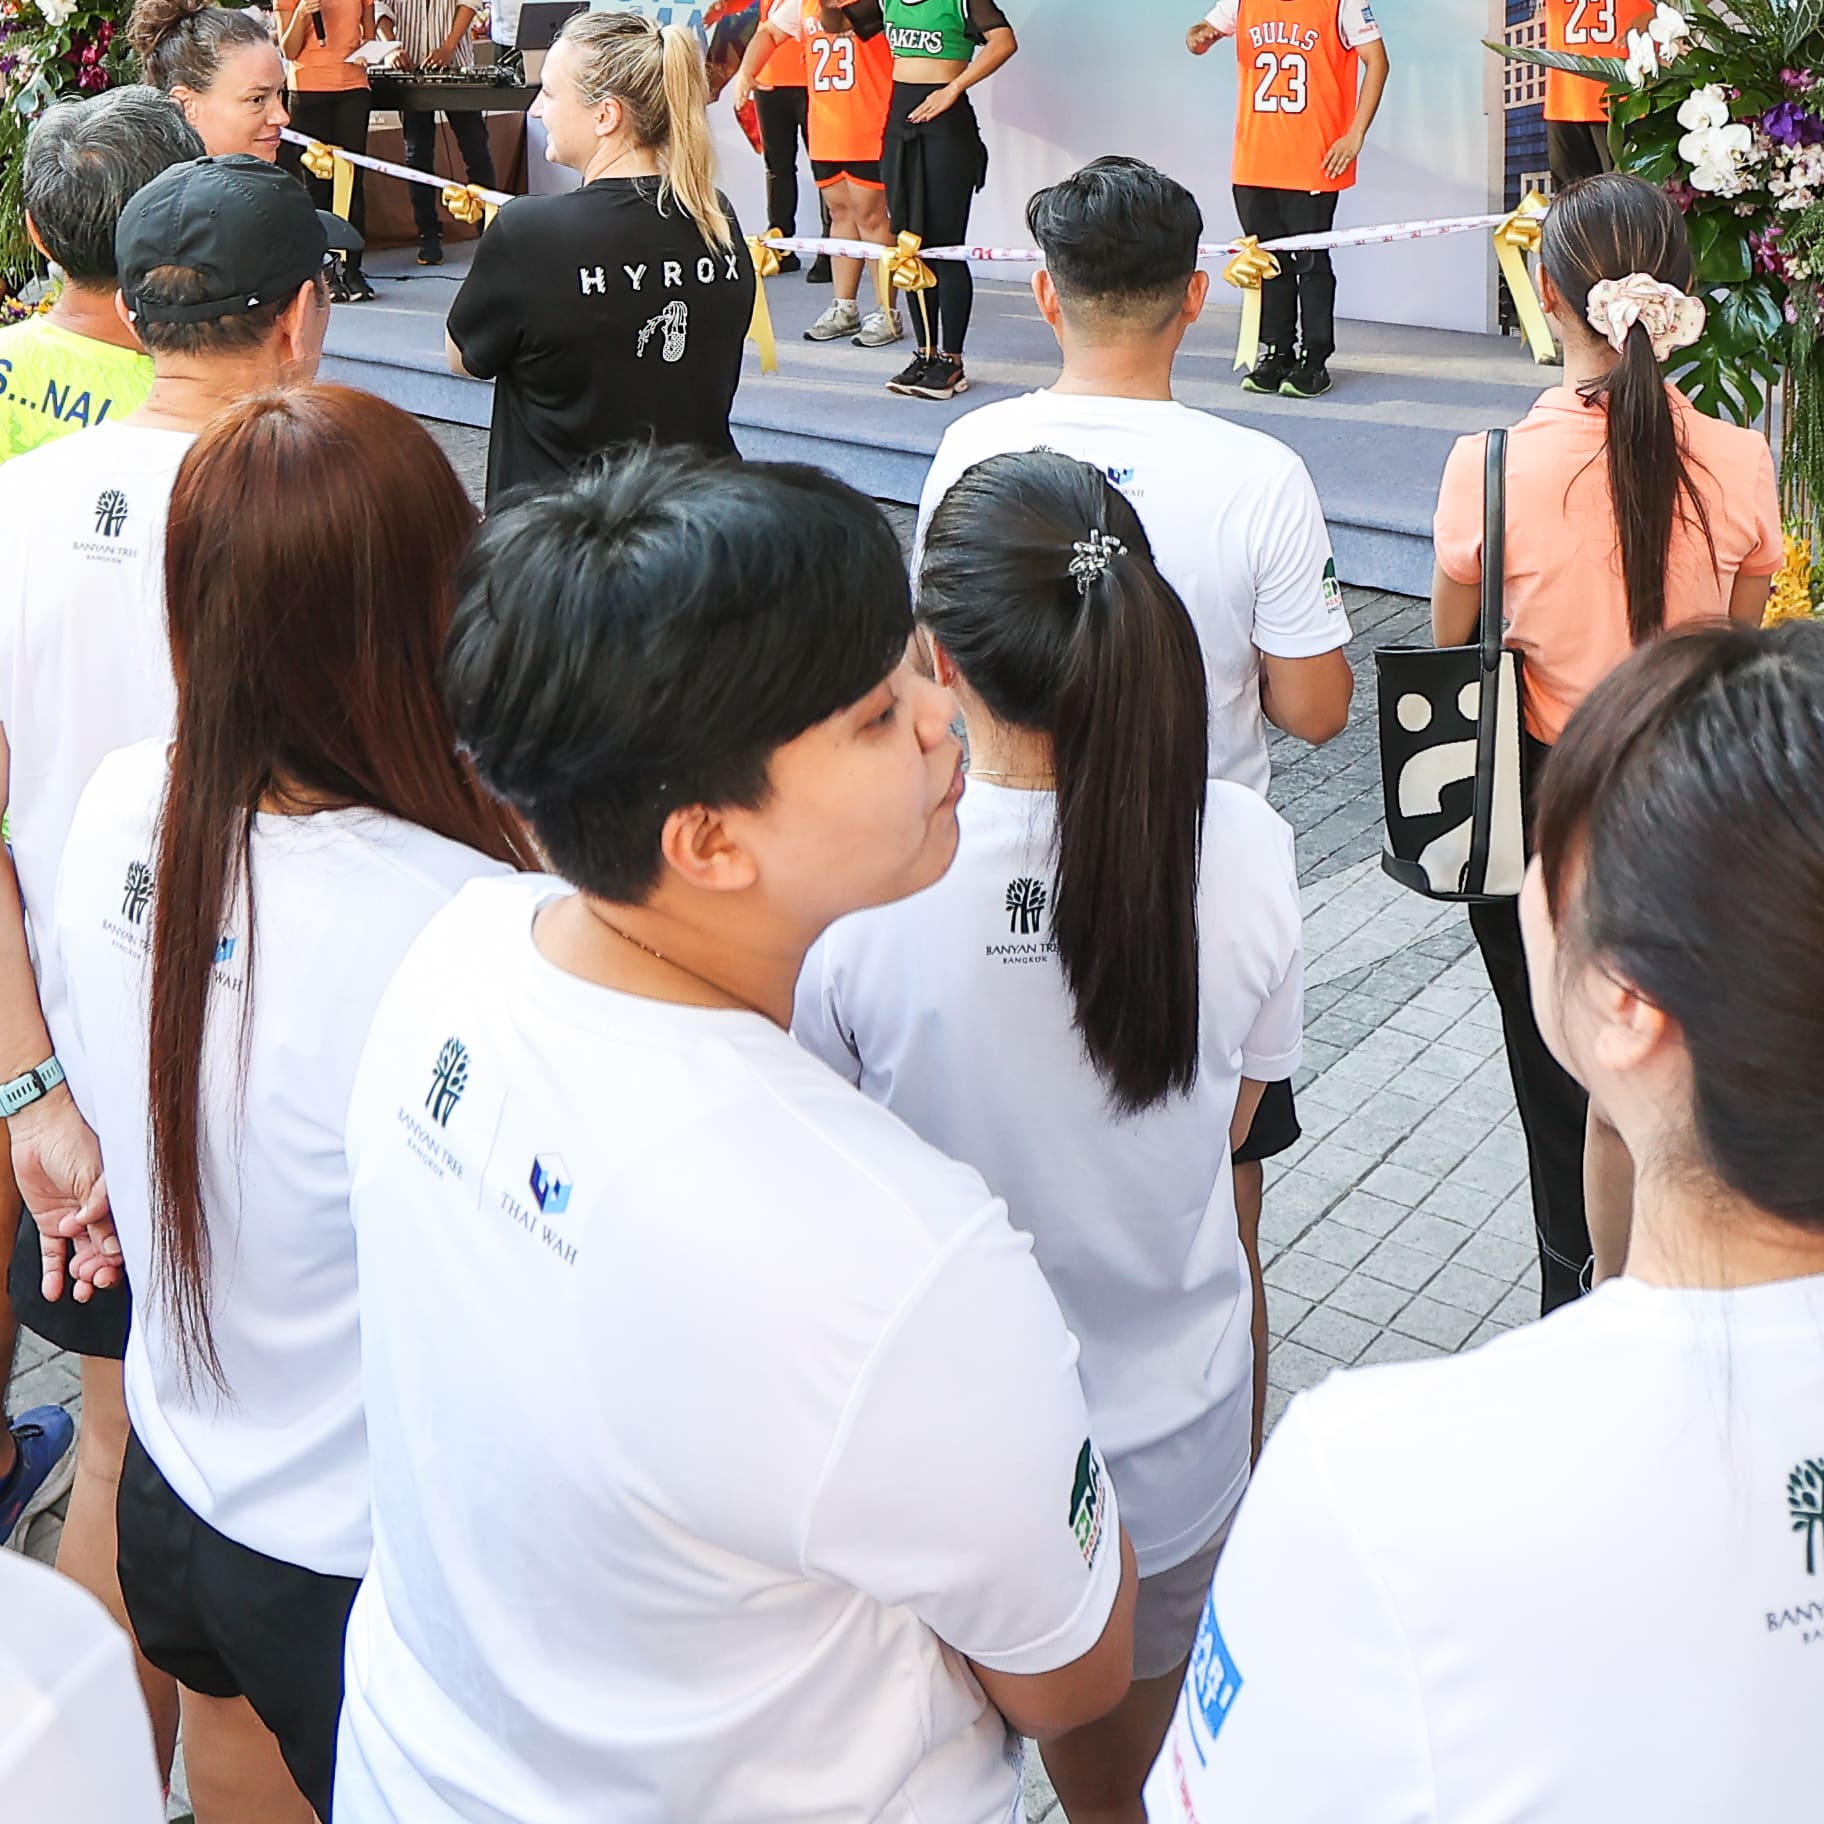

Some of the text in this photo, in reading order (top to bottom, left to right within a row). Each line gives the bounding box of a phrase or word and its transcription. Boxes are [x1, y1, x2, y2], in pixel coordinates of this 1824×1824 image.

[1249, 21, 1319, 51] BULLS
[812, 36, 855, 92] 23
[1254, 52, 1307, 114] 23
[579, 255, 739, 295] HYROX
[73, 542, 114, 555] BANYAN
[986, 944, 1037, 956] BANYAN
[1003, 956, 1047, 964] BANGKOK
[398, 1106, 464, 1180] BANYAN TREE
[501, 1191, 578, 1265] THAI WAH
